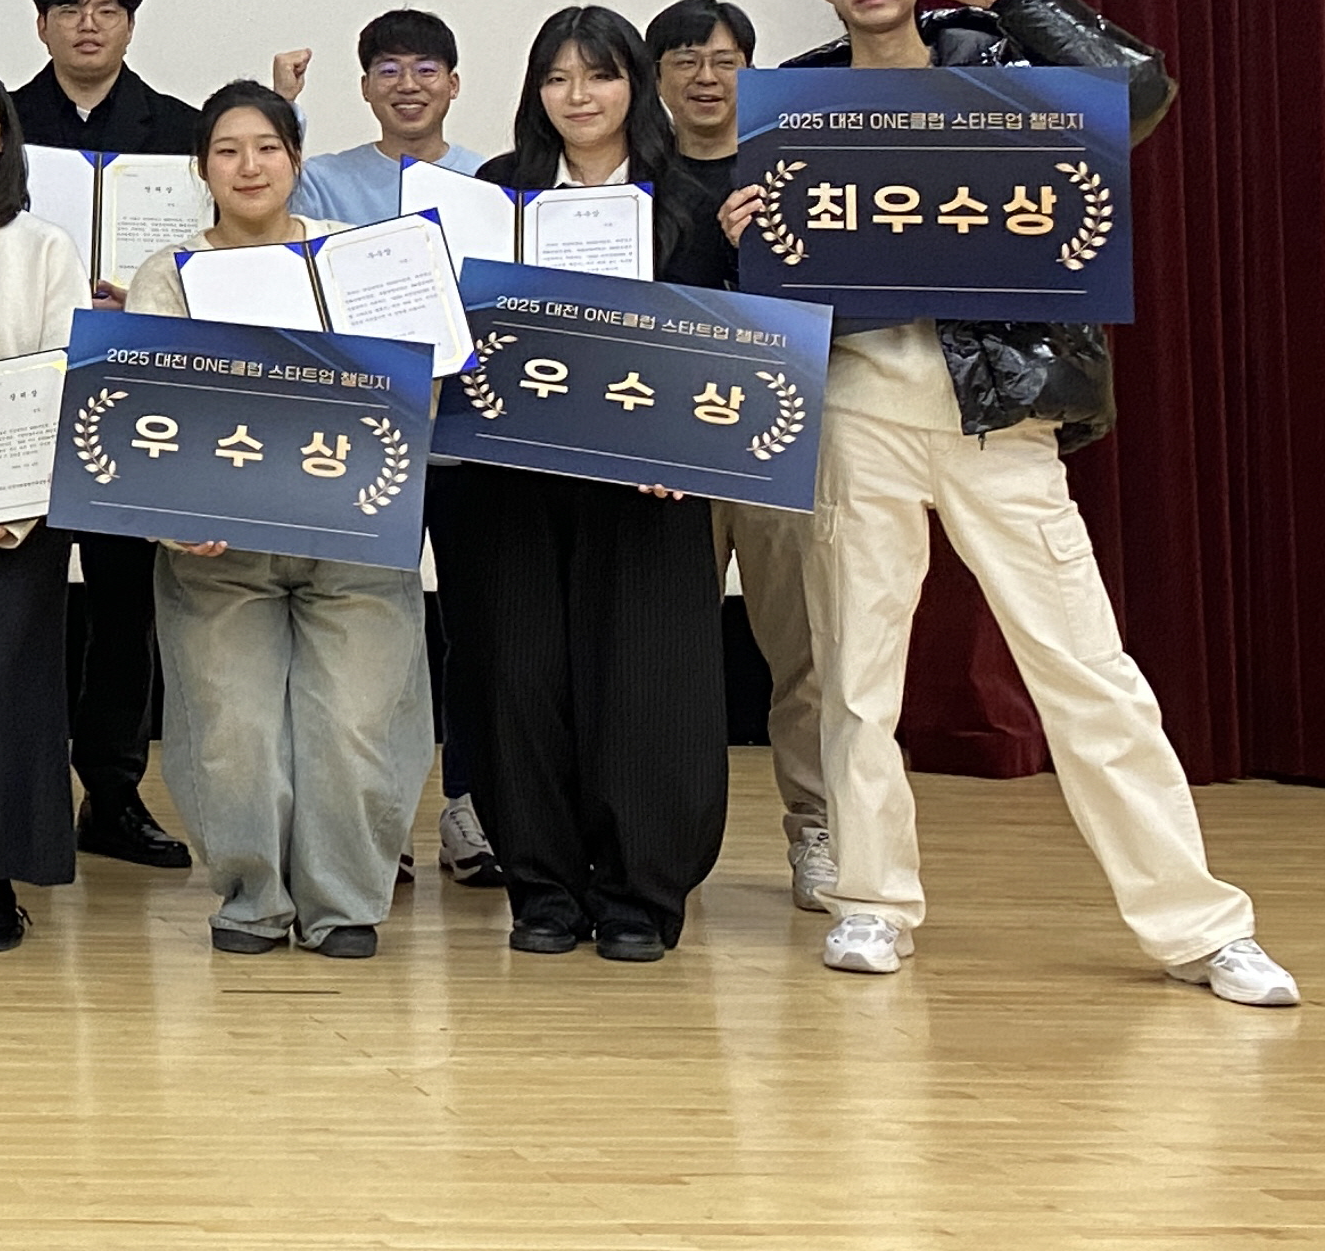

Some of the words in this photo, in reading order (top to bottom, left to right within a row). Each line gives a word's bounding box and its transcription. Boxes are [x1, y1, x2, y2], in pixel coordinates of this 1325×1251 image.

[779, 113, 823, 129] 2025
[830, 113, 863, 129] 대전
[870, 113, 944, 129] ONE클럽
[952, 113, 1022, 129] 스타트업
[805, 181, 1058, 236] 최우수상
[496, 296, 540, 313] 2025
[546, 302, 578, 318] 대전
[584, 308, 655, 329] ONE클럽
[661, 319, 729, 340] 스타트업
[107, 349, 149, 365] 2025
[155, 353, 187, 369] 대전
[193, 357, 263, 377] ONE클럽
[268, 365, 334, 384] 스타트업
